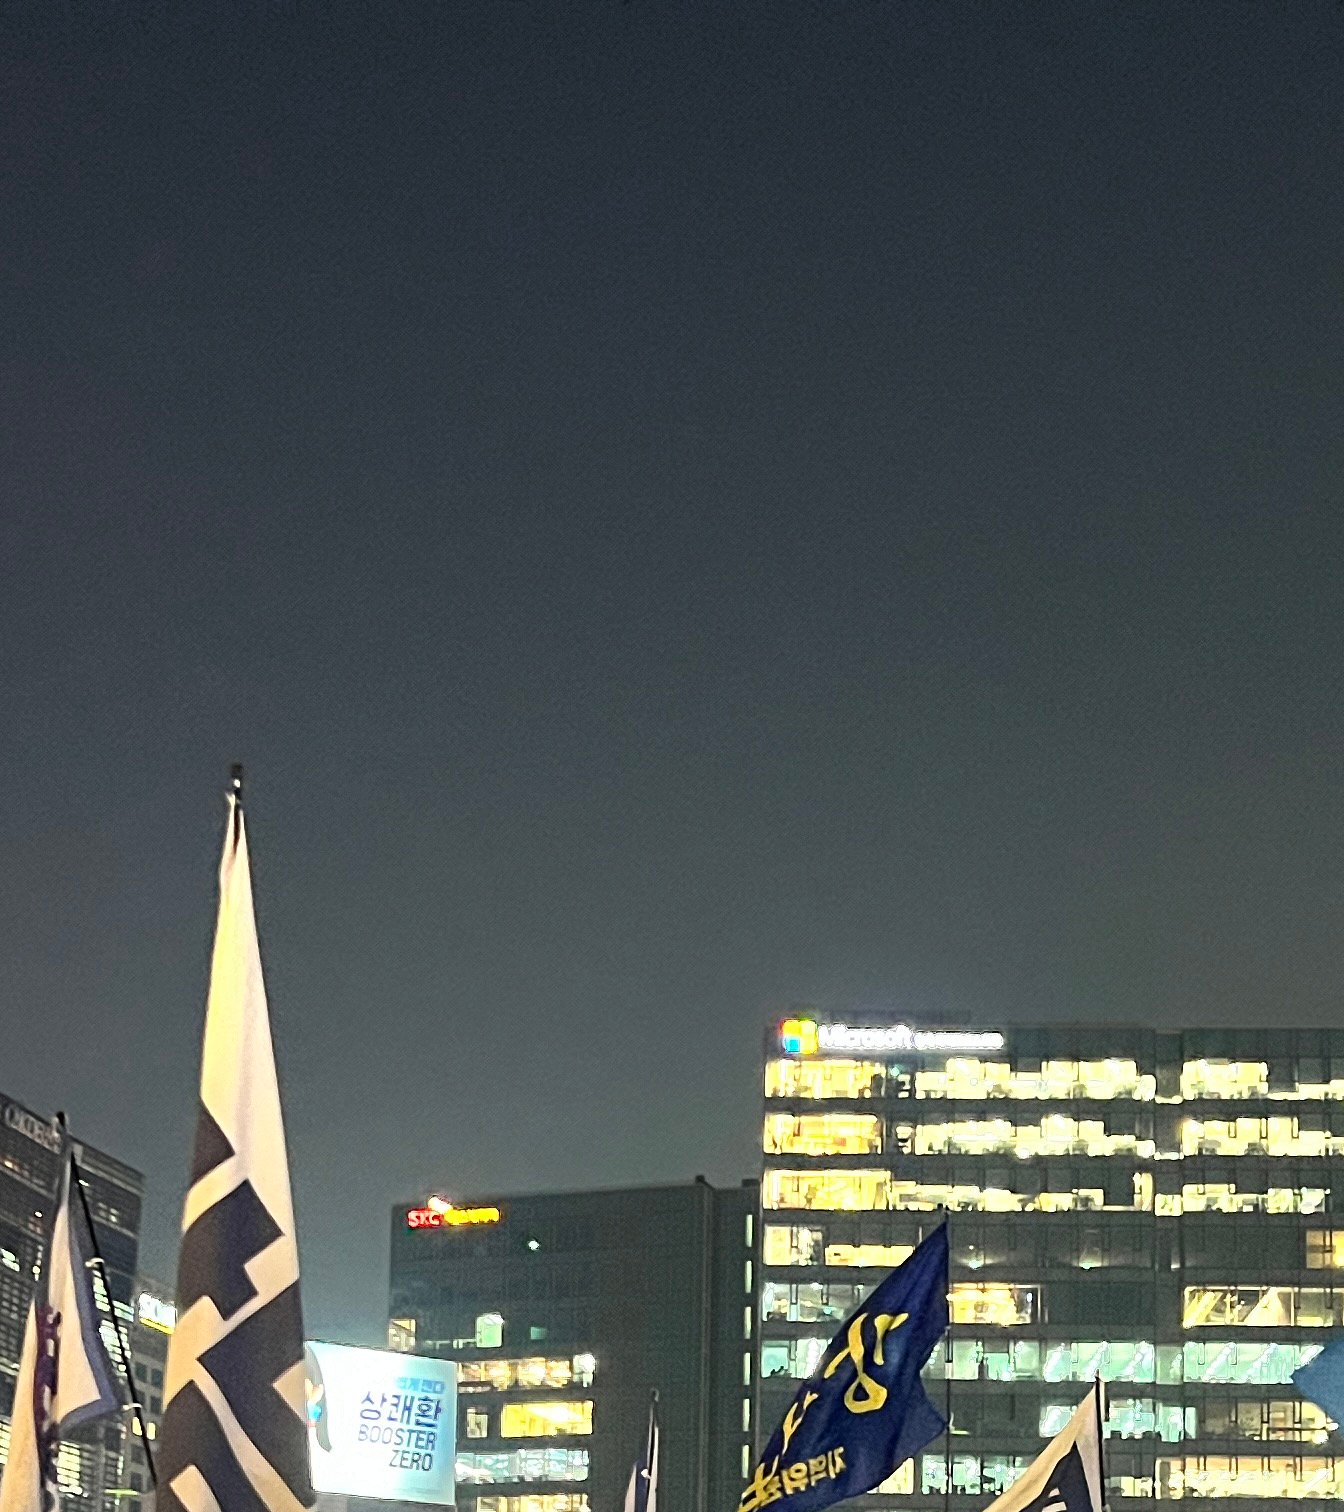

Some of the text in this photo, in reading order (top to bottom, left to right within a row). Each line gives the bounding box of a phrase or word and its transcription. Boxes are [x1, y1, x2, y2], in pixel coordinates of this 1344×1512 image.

[359, 1391, 442, 1430] 상쾌환
[358, 1424, 436, 1451] BOOSTER
[389, 1450, 433, 1471] ZERO
